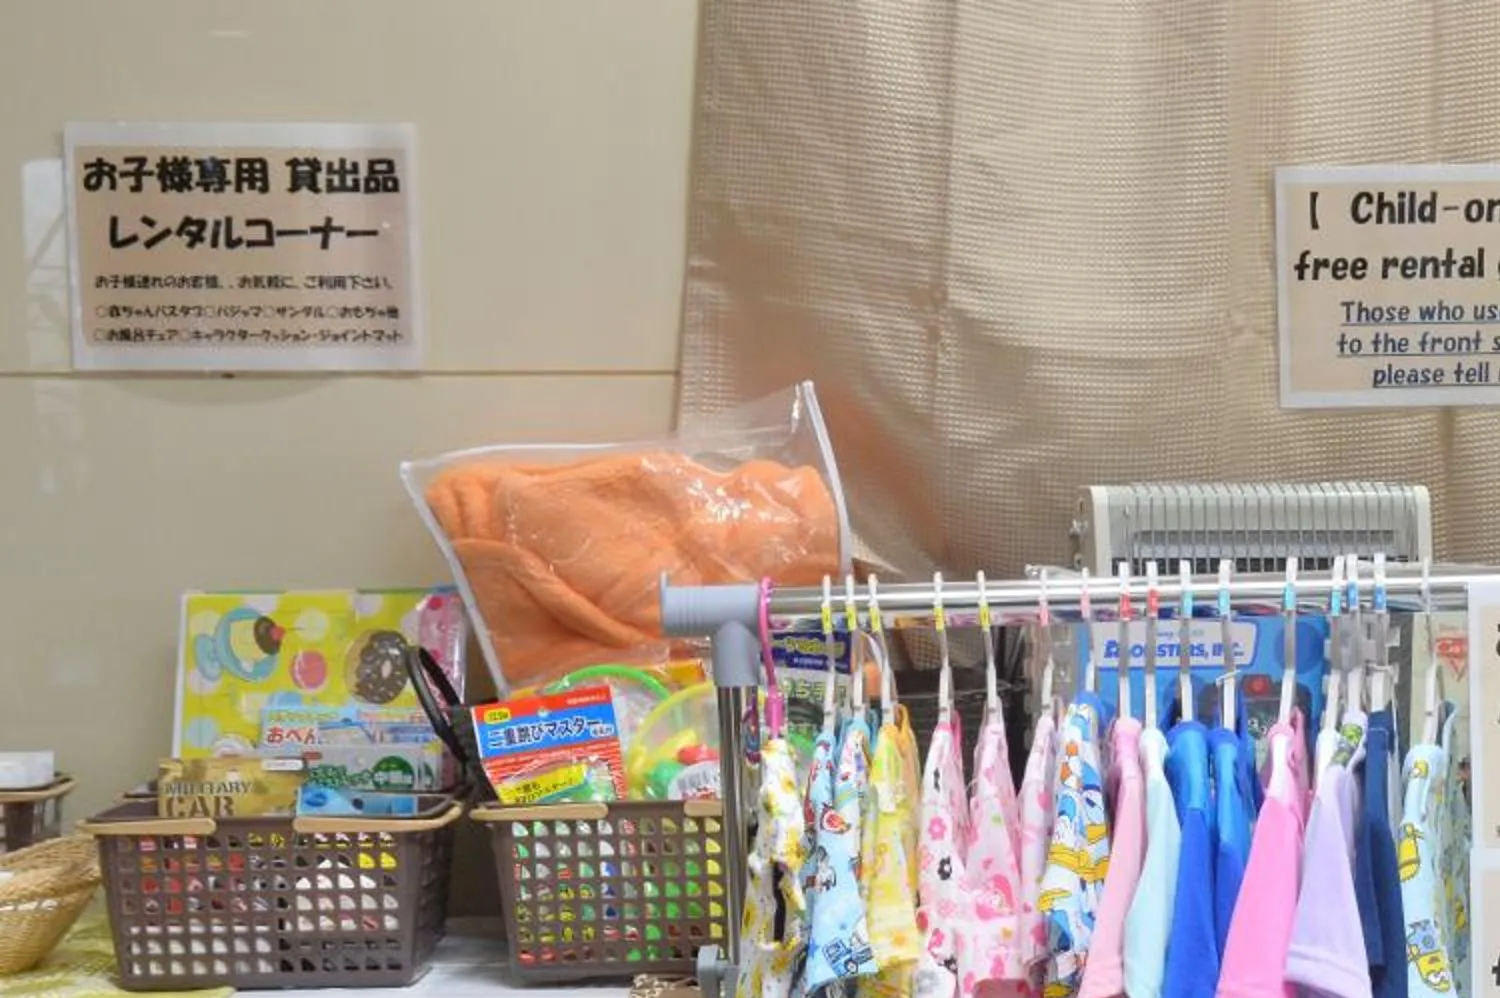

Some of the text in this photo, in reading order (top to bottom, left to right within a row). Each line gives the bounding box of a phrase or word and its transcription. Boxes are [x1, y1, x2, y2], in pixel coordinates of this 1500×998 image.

[83, 156, 401, 195] お子様専用 貸出品
[109, 215, 379, 250] レンタルコーナー
[1294, 250, 1369, 281] free
[1381, 247, 1485, 280] rental
[1341, 301, 1410, 322] Those
[1418, 300, 1465, 321] who
[1337, 332, 1362, 354] to
[1371, 332, 1409, 353] the
[1418, 330, 1482, 351] front
[1373, 363, 1445, 387] please
[1454, 361, 1490, 383] tell
[166, 795, 235, 818] CAR
